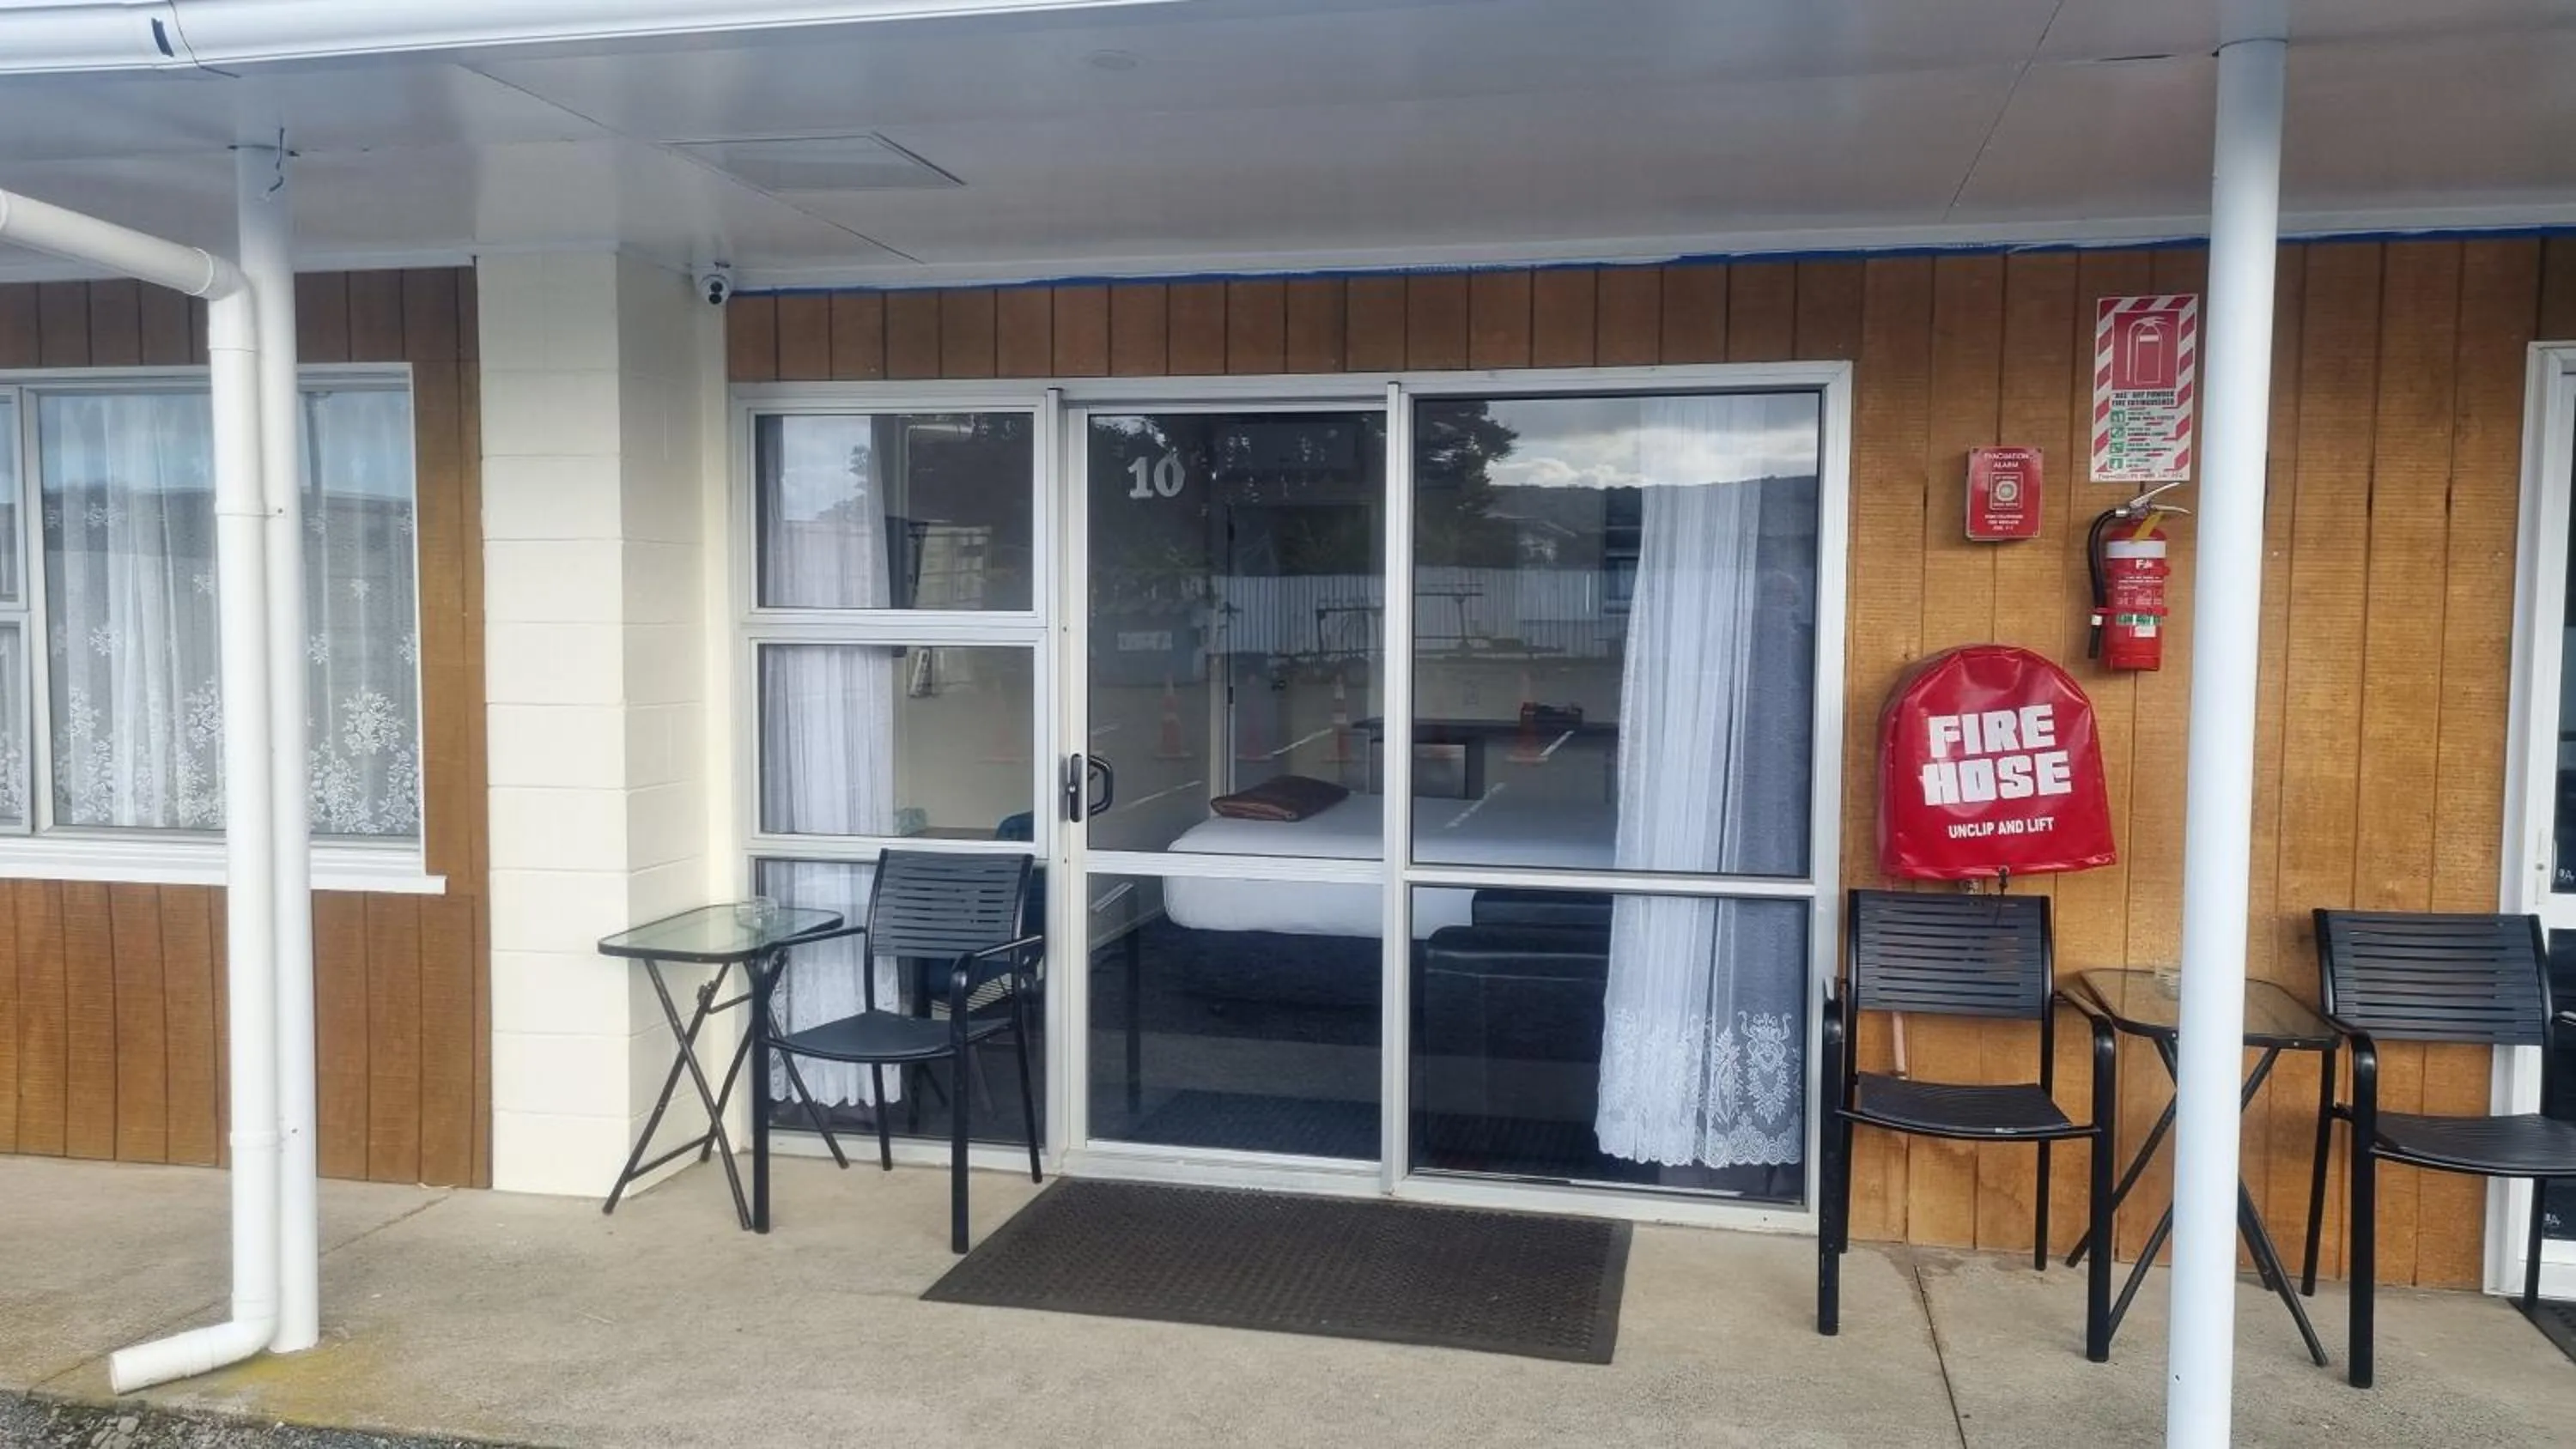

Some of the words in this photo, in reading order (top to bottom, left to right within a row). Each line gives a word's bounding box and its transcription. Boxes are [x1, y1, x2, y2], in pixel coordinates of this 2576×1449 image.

[1127, 455, 1186, 499] 10
[1928, 704, 2056, 758] FIRE
[1923, 750, 2072, 806] HOSE
[1948, 822, 1994, 839] UNCLIP
[1998, 819, 2024, 834] AND
[2027, 817, 2054, 833] LIFT
